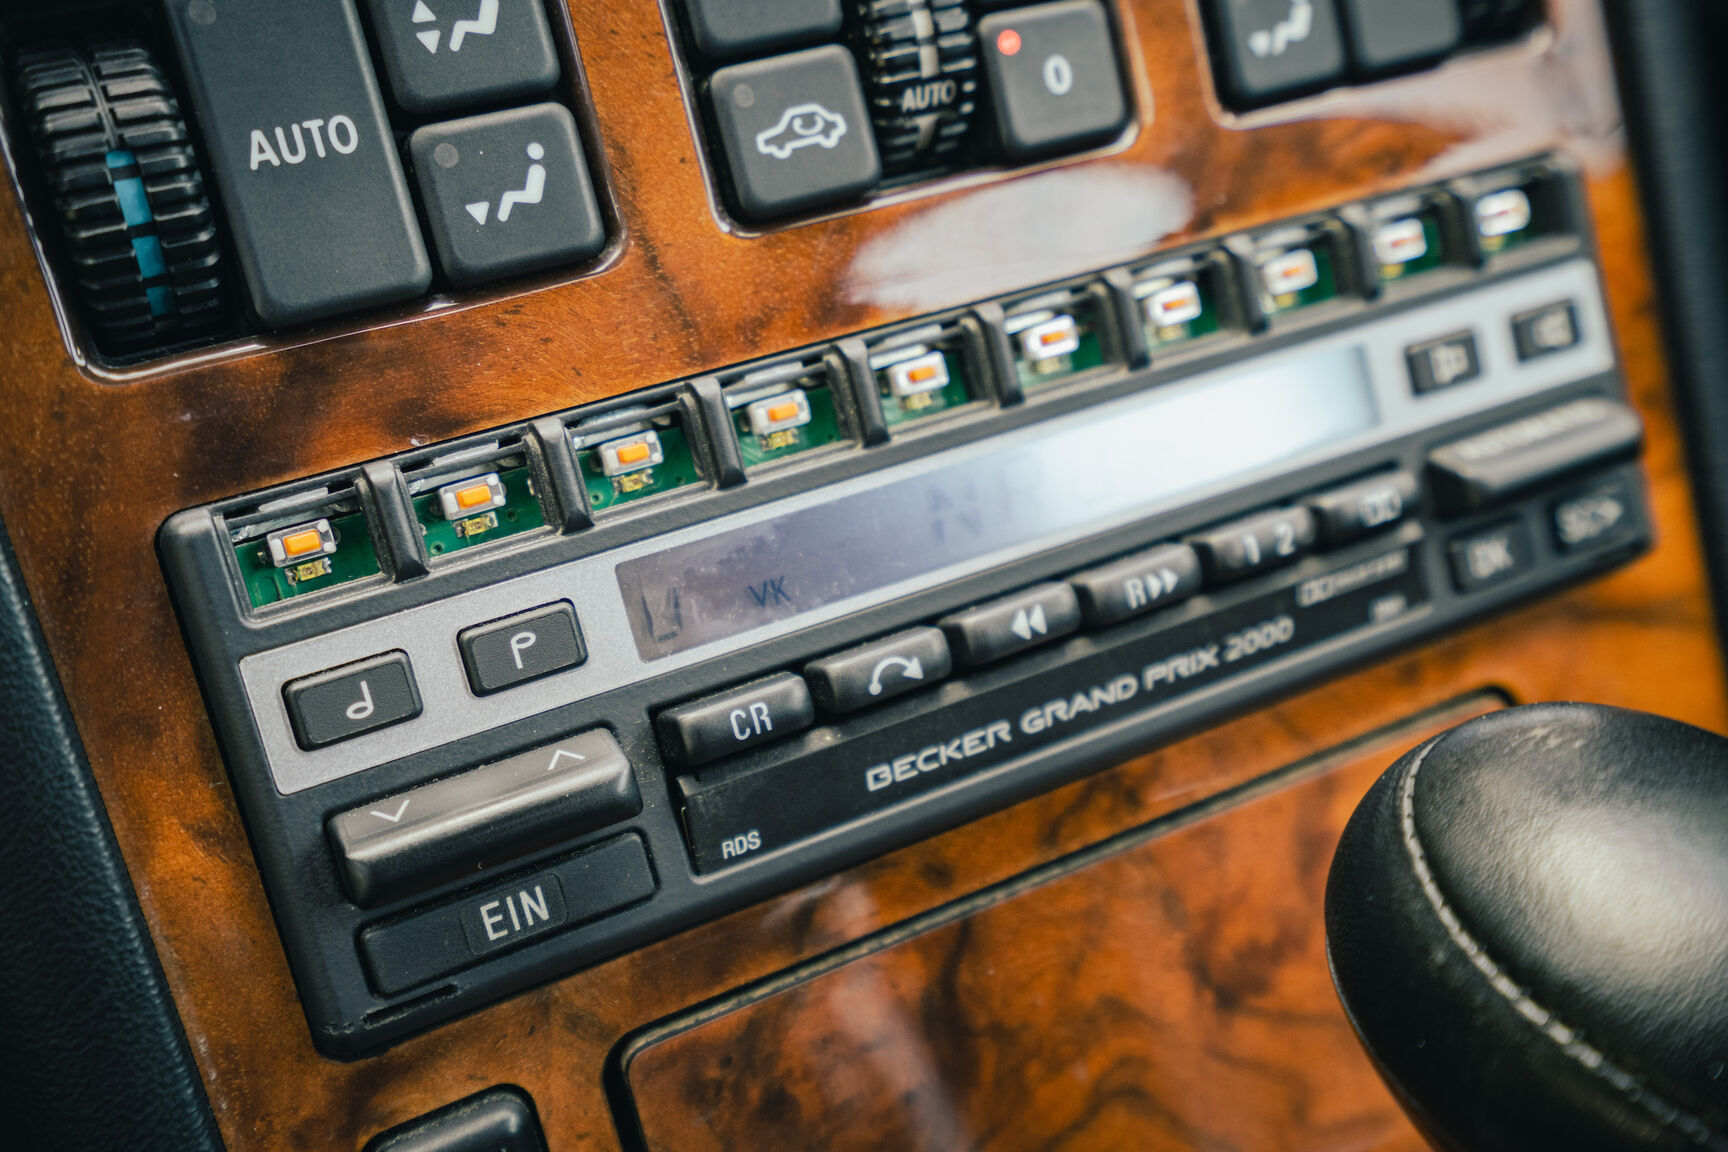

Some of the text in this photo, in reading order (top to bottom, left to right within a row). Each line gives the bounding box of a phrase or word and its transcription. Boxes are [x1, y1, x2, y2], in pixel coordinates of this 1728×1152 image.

[902, 79, 956, 113] AUTO
[248, 114, 359, 171] AUTO
[748, 576, 792, 608] VK
[730, 702, 773, 741] CR
[866, 615, 1295, 791] BECKER GRAND PRIX 2000
[722, 830, 762, 859] RDS
[480, 884, 551, 941] EIN
